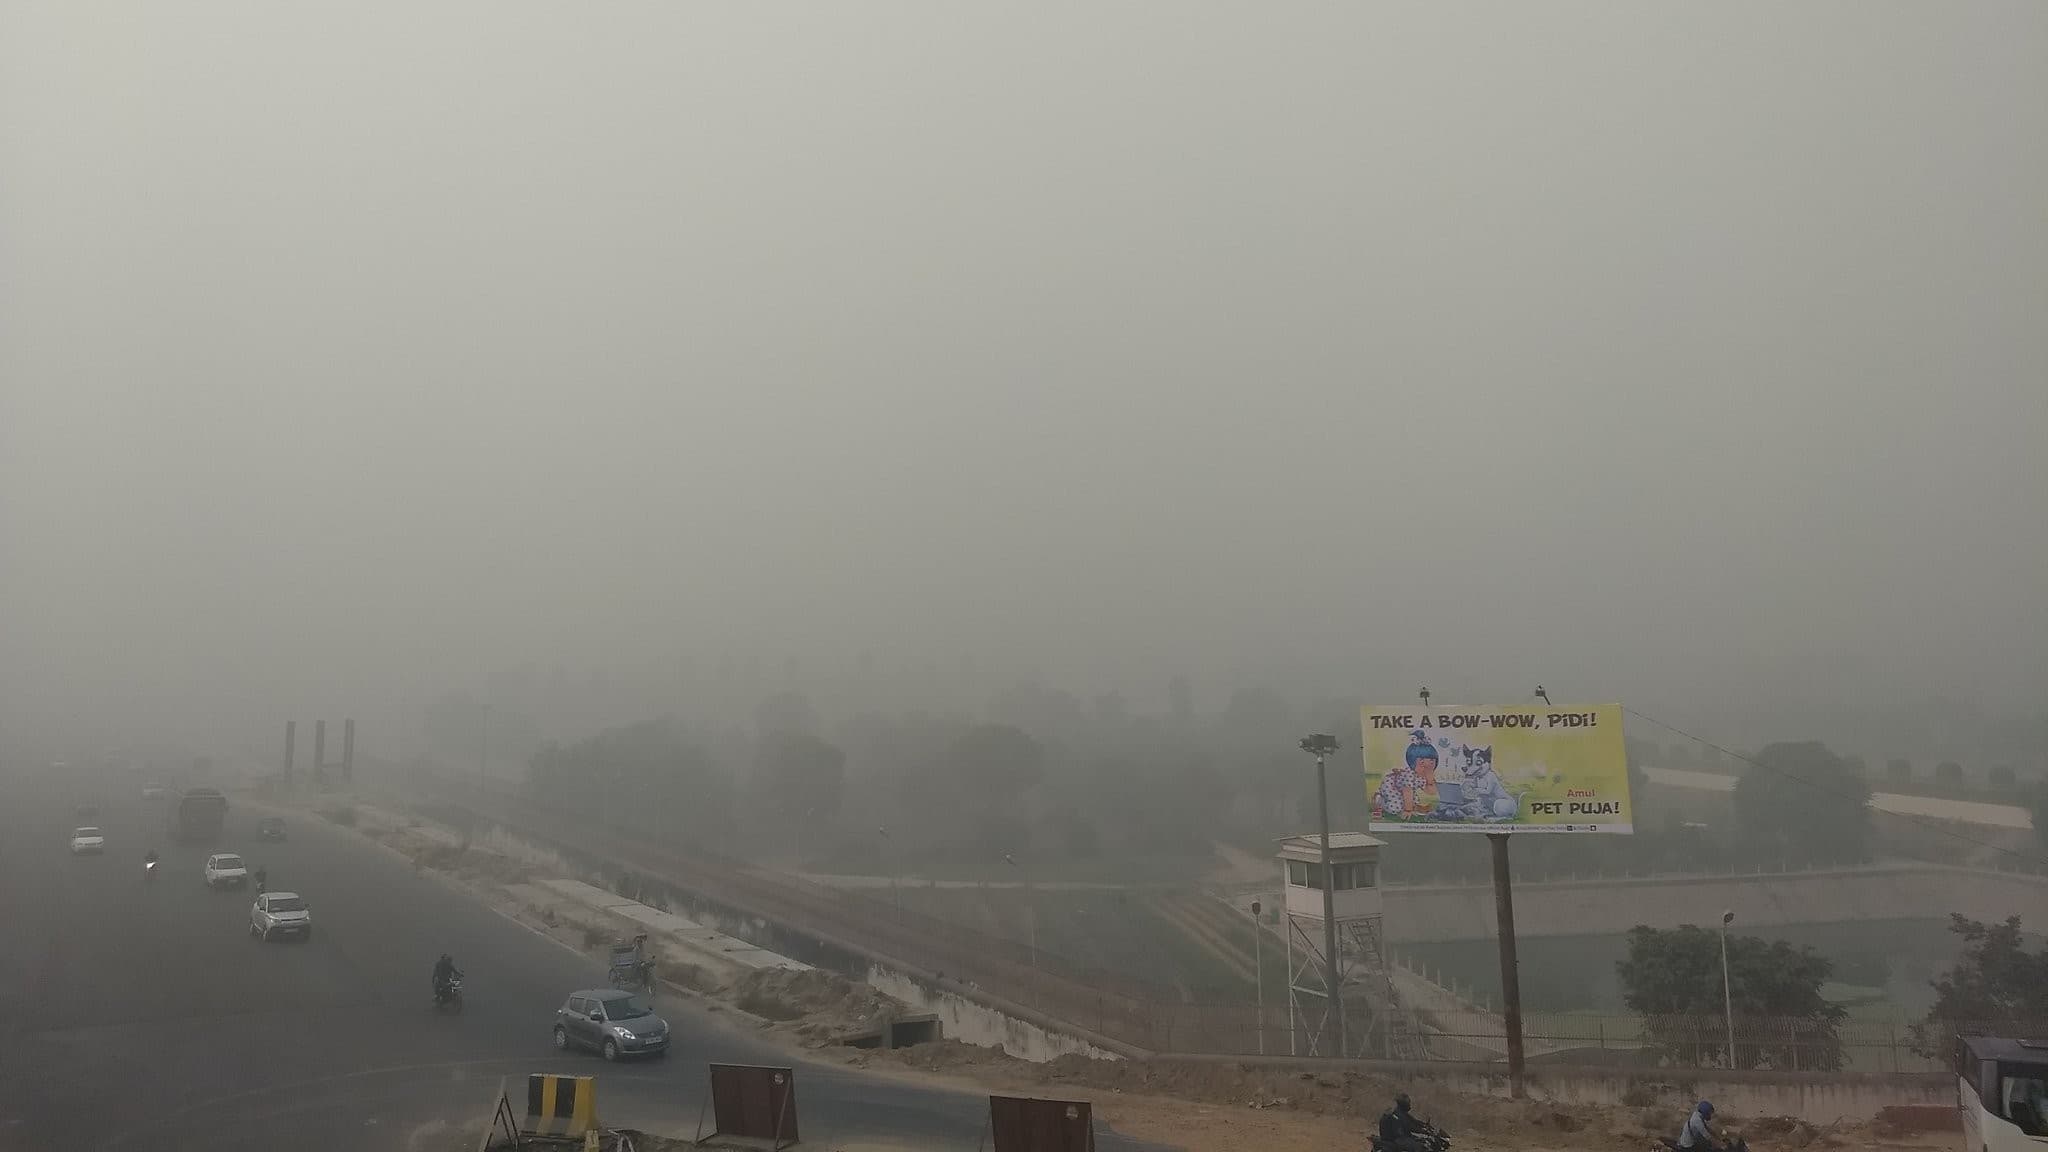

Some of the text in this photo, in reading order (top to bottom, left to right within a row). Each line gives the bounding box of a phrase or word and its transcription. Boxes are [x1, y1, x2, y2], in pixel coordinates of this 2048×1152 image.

[1370, 714, 1414, 729] TAKE
[1419, 714, 1433, 728] A
[1438, 713, 1540, 730] BOW-WOW,
[1567, 789, 1595, 798] Amul
[1531, 801, 1620, 815] PET PUJA!
